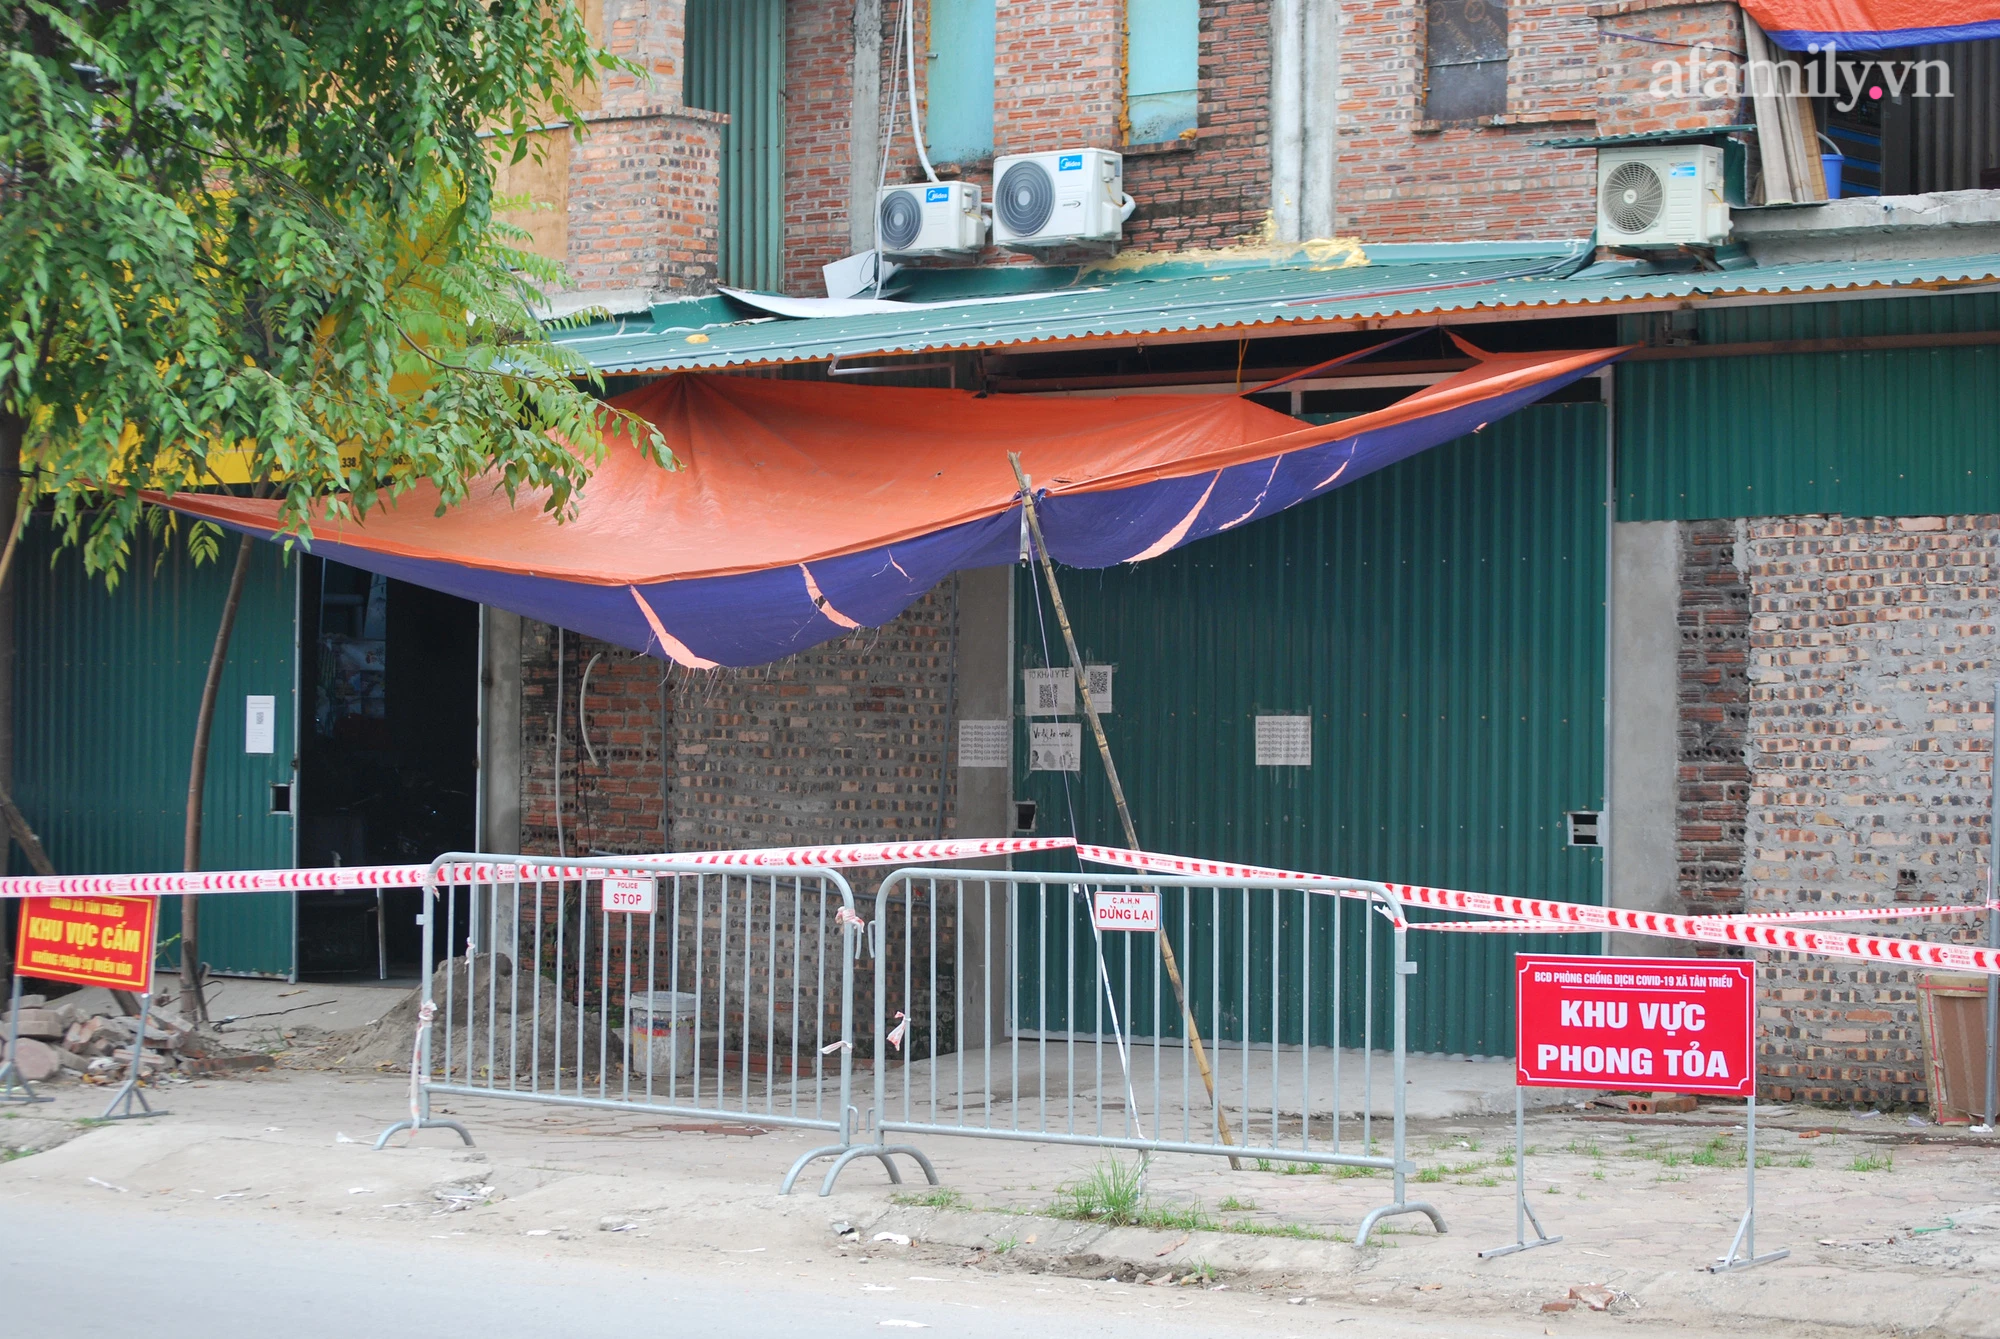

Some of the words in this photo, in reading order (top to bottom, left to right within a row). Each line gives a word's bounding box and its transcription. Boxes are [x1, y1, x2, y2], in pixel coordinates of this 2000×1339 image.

[617, 881, 638, 889] POLICE
[613, 893, 642, 905] STOP
[1099, 905, 1131, 920] DỪNG
[1134, 909, 1154, 923] LẠI
[29, 916, 64, 942] KHU
[66, 921, 99, 950] VỰC
[101, 921, 141, 953] CẤM
[1554, 970, 1583, 984] PHÒNG
[1583, 970, 1613, 985] CHỐNG
[1614, 974, 1635, 987] DỊCH
[1635, 975, 1674, 987] COVID-19
[1675, 974, 1688, 987] XÃ
[1689, 974, 1707, 987] TÂN
[1560, 999, 1628, 1029] KHU
[1638, 1000, 1706, 1036] VỰC
[1537, 1043, 1653, 1075] PHONG
[1663, 1040, 1730, 1078] TỎA
